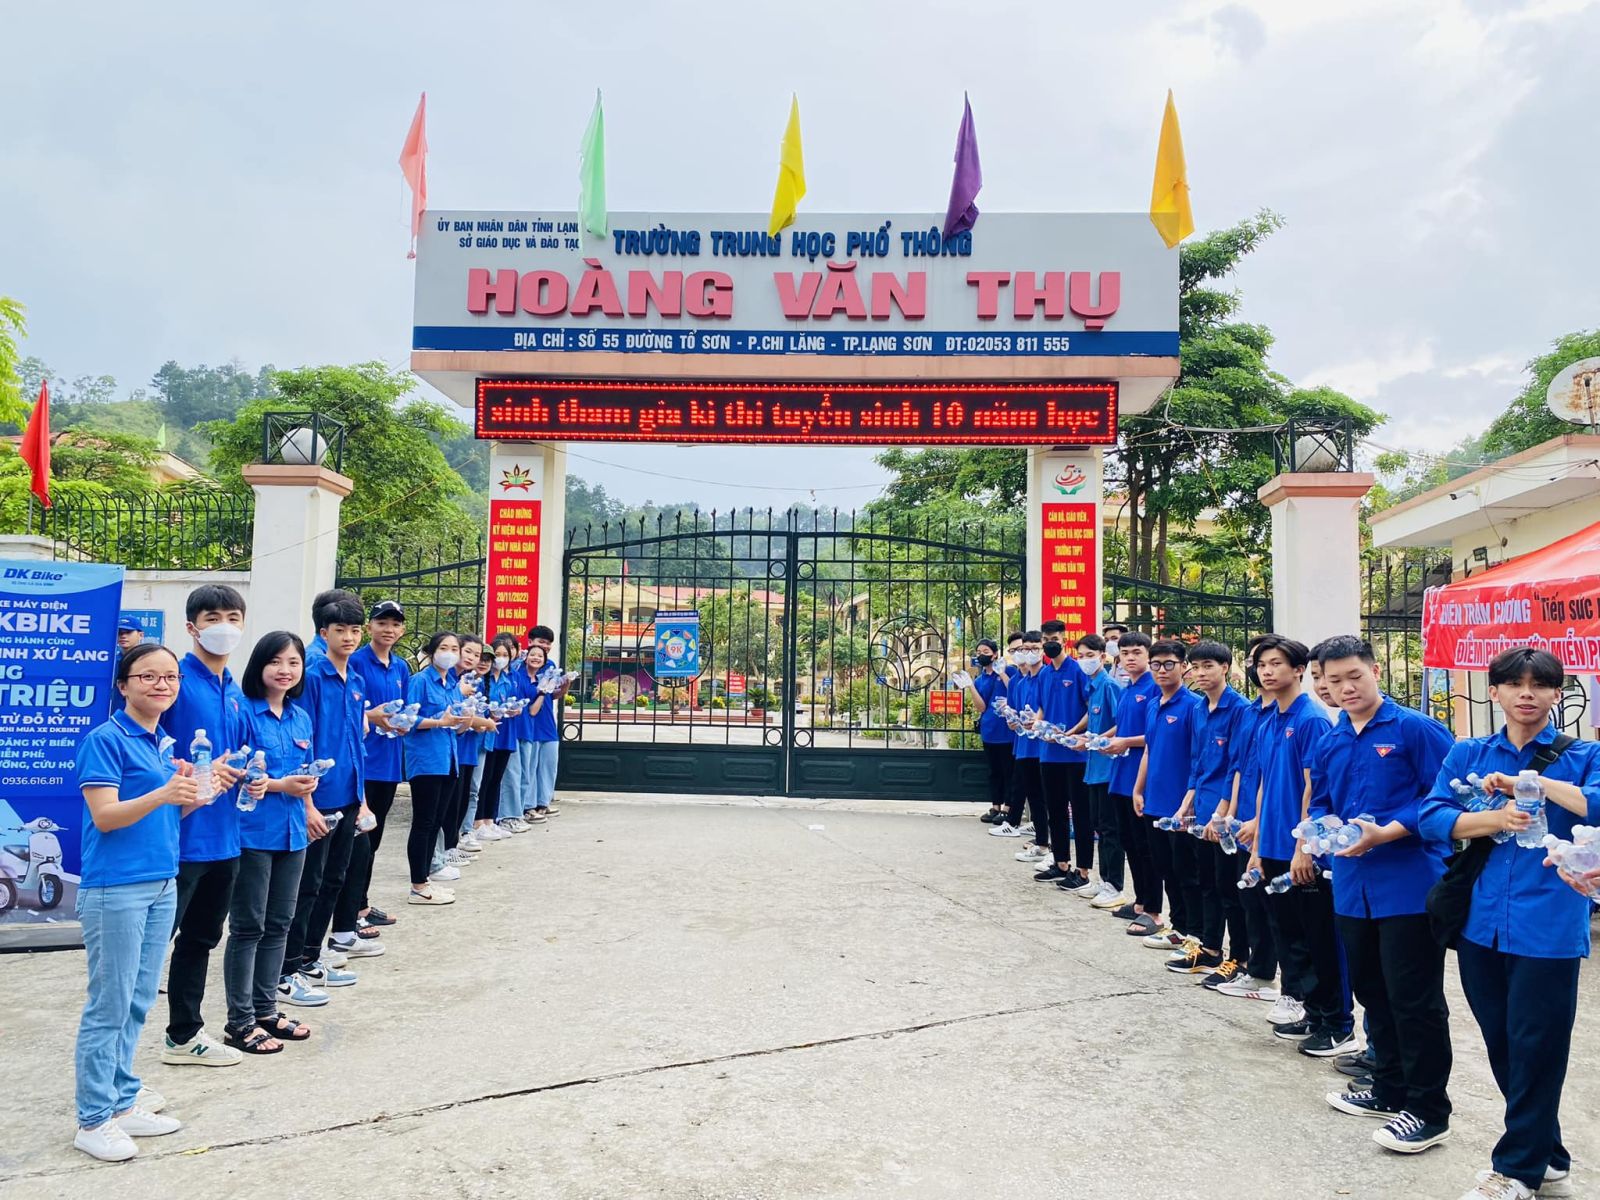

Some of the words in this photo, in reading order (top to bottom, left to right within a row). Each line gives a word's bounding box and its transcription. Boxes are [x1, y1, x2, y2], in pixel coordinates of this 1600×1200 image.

[454, 221, 473, 232] BAN
[477, 219, 503, 232] NHÂN
[508, 219, 528, 232] DÂN
[532, 217, 553, 232] TỈNH
[459, 232, 472, 248] SỞ
[476, 235, 498, 248] GIÁO
[502, 238, 520, 250] DỤC
[526, 235, 536, 248] VÀ
[540, 235, 559, 248] ĐÀO
[612, 224, 700, 256] TRƯỜNG
[711, 231, 781, 257] TRUNG
[792, 231, 836, 262] HỌC
[846, 220, 892, 257] PHỔ
[901, 226, 972, 257] THÔNG
[466, 258, 734, 319] HOÀNG
[773, 260, 926, 321] VĂN
[967, 272, 1120, 330] THỤ
[514, 333, 536, 350] ĐỊA
[542, 329, 564, 346] CHỈ
[578, 330, 596, 347] SỐ
[602, 334, 619, 348] 55
[626, 330, 672, 348] ĐƯỜNG
[680, 330, 696, 348] TỔ
[702, 335, 730, 350] SƠN
[748, 335, 784, 350] P.CHI
[790, 332, 825, 350] LĂNG
[843, 336, 896, 354] TP.LẠNG
[903, 336, 932, 350] SƠN
[946, 336, 1011, 351] ĐT:02053
[1016, 337, 1038, 351] 811
[1043, 337, 1070, 351] 555
[490, 397, 550, 422] sinh
[558, 398, 631, 424] tham
[639, 400, 682, 432] gia
[724, 400, 764, 425] thi
[772, 394, 852, 433] tuyển
[860, 401, 920, 428] sinh
[933, 401, 964, 427] 10
[973, 401, 1038, 427] năm
[1047, 400, 1100, 434] học
[500, 507, 514, 519] CHÀO
[517, 525, 523, 536] 40
[525, 524, 538, 536] NĂM
[494, 540, 508, 552] NGÀY
[509, 540, 521, 552] NHÀ
[522, 540, 536, 552] GIÁO
[501, 557, 513, 571] VIỆT
[514, 558, 527, 569] NAM
[4, 568, 31, 579] DK
[31, 571, 63, 581] Bike
[13, 599, 38, 609] MÁY
[41, 600, 68, 612] ĐIỆN
[497, 607, 504, 619] VÀ
[505, 608, 512, 619] 05
[514, 607, 527, 619] NĂM
[515, 624, 526, 638] LẬP
[15, 636, 44, 644] HÀNH
[47, 636, 75, 645] CÙNG
[32, 646, 59, 660] XỨ
[62, 650, 109, 664] LẠNG
[1456, 632, 1483, 664] ĐIỂM
[1485, 634, 1511, 664] PHÁ
[1587, 638, 1600, 668] P
[1, 712, 20, 724] TỬ
[22, 712, 44, 724] ĐỖ
[47, 714, 65, 725] KỲ
[68, 716, 91, 725] THI
[32, 738, 47, 747] KÝ
[22, 749, 45, 758] PHÍ:
[32, 759, 56, 769] CỨU
[58, 759, 75, 770] HỘ
